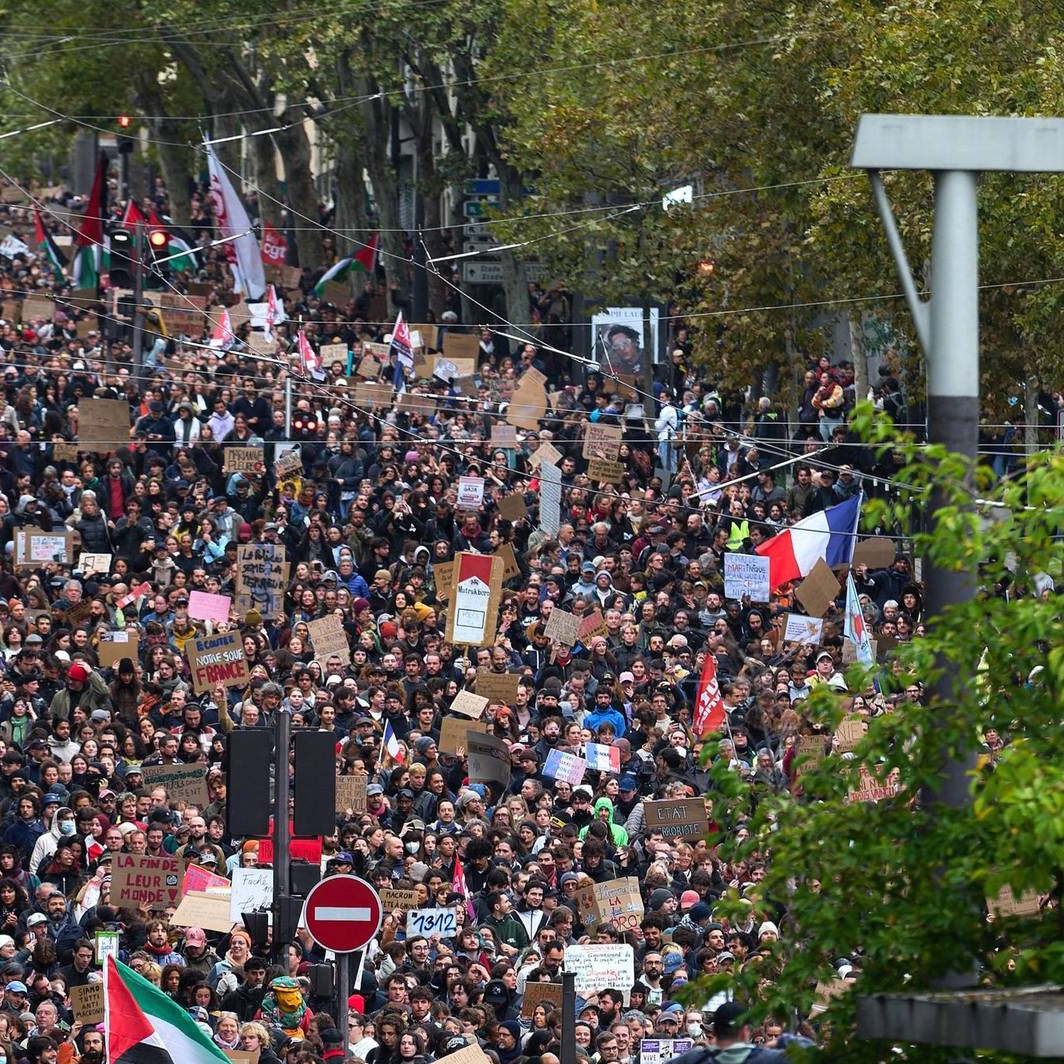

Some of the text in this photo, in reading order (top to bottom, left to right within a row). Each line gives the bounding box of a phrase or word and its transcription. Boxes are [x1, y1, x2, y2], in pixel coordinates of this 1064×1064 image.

[264, 244, 286, 259] cgt
[196, 661, 245, 686] FRANCE
[657, 805, 688, 819] ETAT
[117, 856, 179, 871] LA FIN DE
[126, 873, 161, 887] LEUR
[120, 889, 165, 903] MONDE
[386, 890, 413, 899] MACRON
[609, 896, 621, 906] LA
[413, 913, 457, 932] 1312
[79, 986, 100, 996] SIAMO
[79, 994, 99, 1003] TUTTI
[82, 1002, 98, 1010] ANTI
